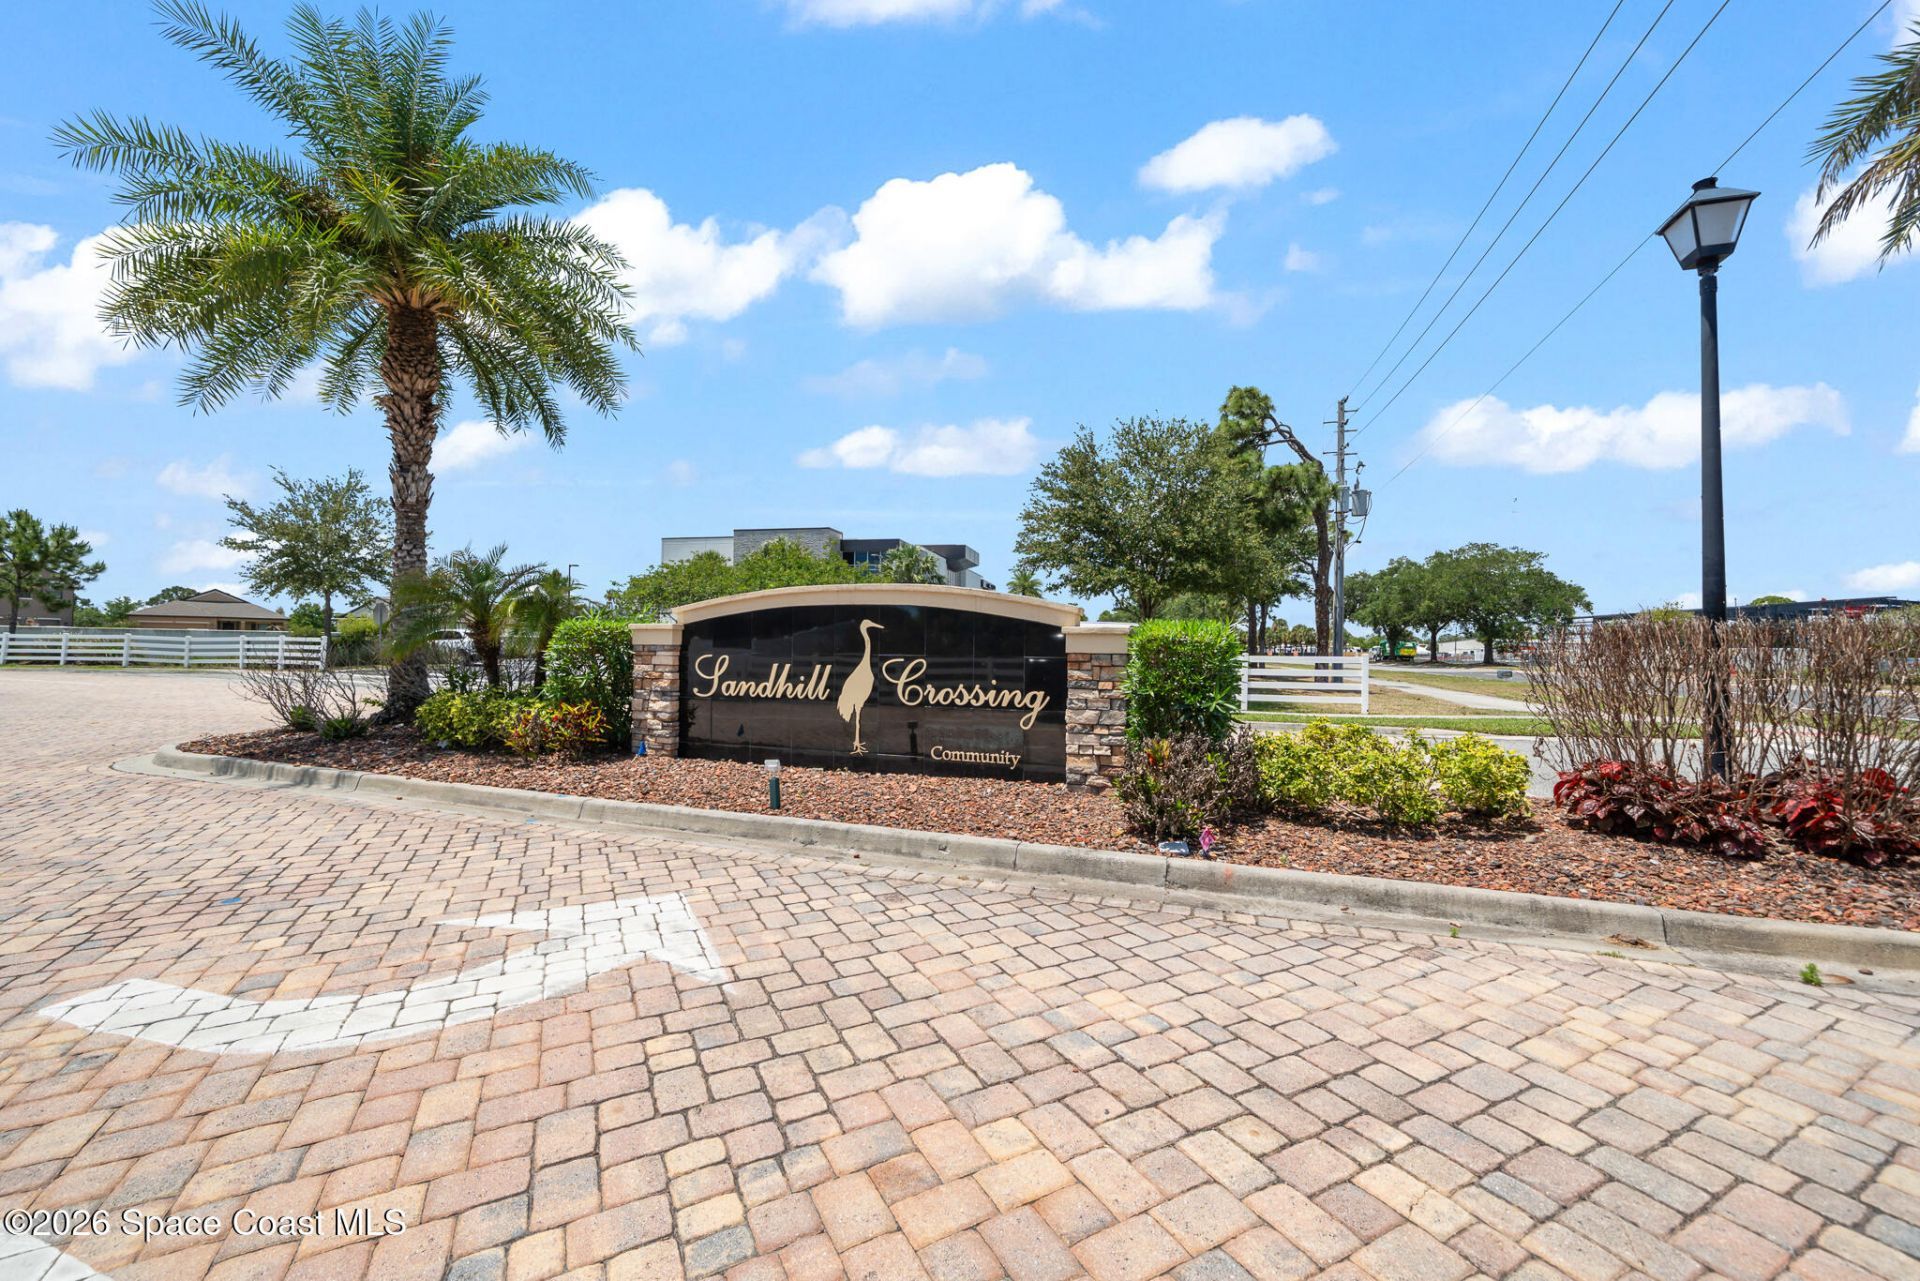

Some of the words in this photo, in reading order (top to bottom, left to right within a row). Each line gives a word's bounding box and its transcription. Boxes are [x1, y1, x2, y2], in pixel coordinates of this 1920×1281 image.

[693, 653, 832, 700] Sandhill
[882, 657, 1050, 730] Crossing
[930, 745, 1021, 770] Community
